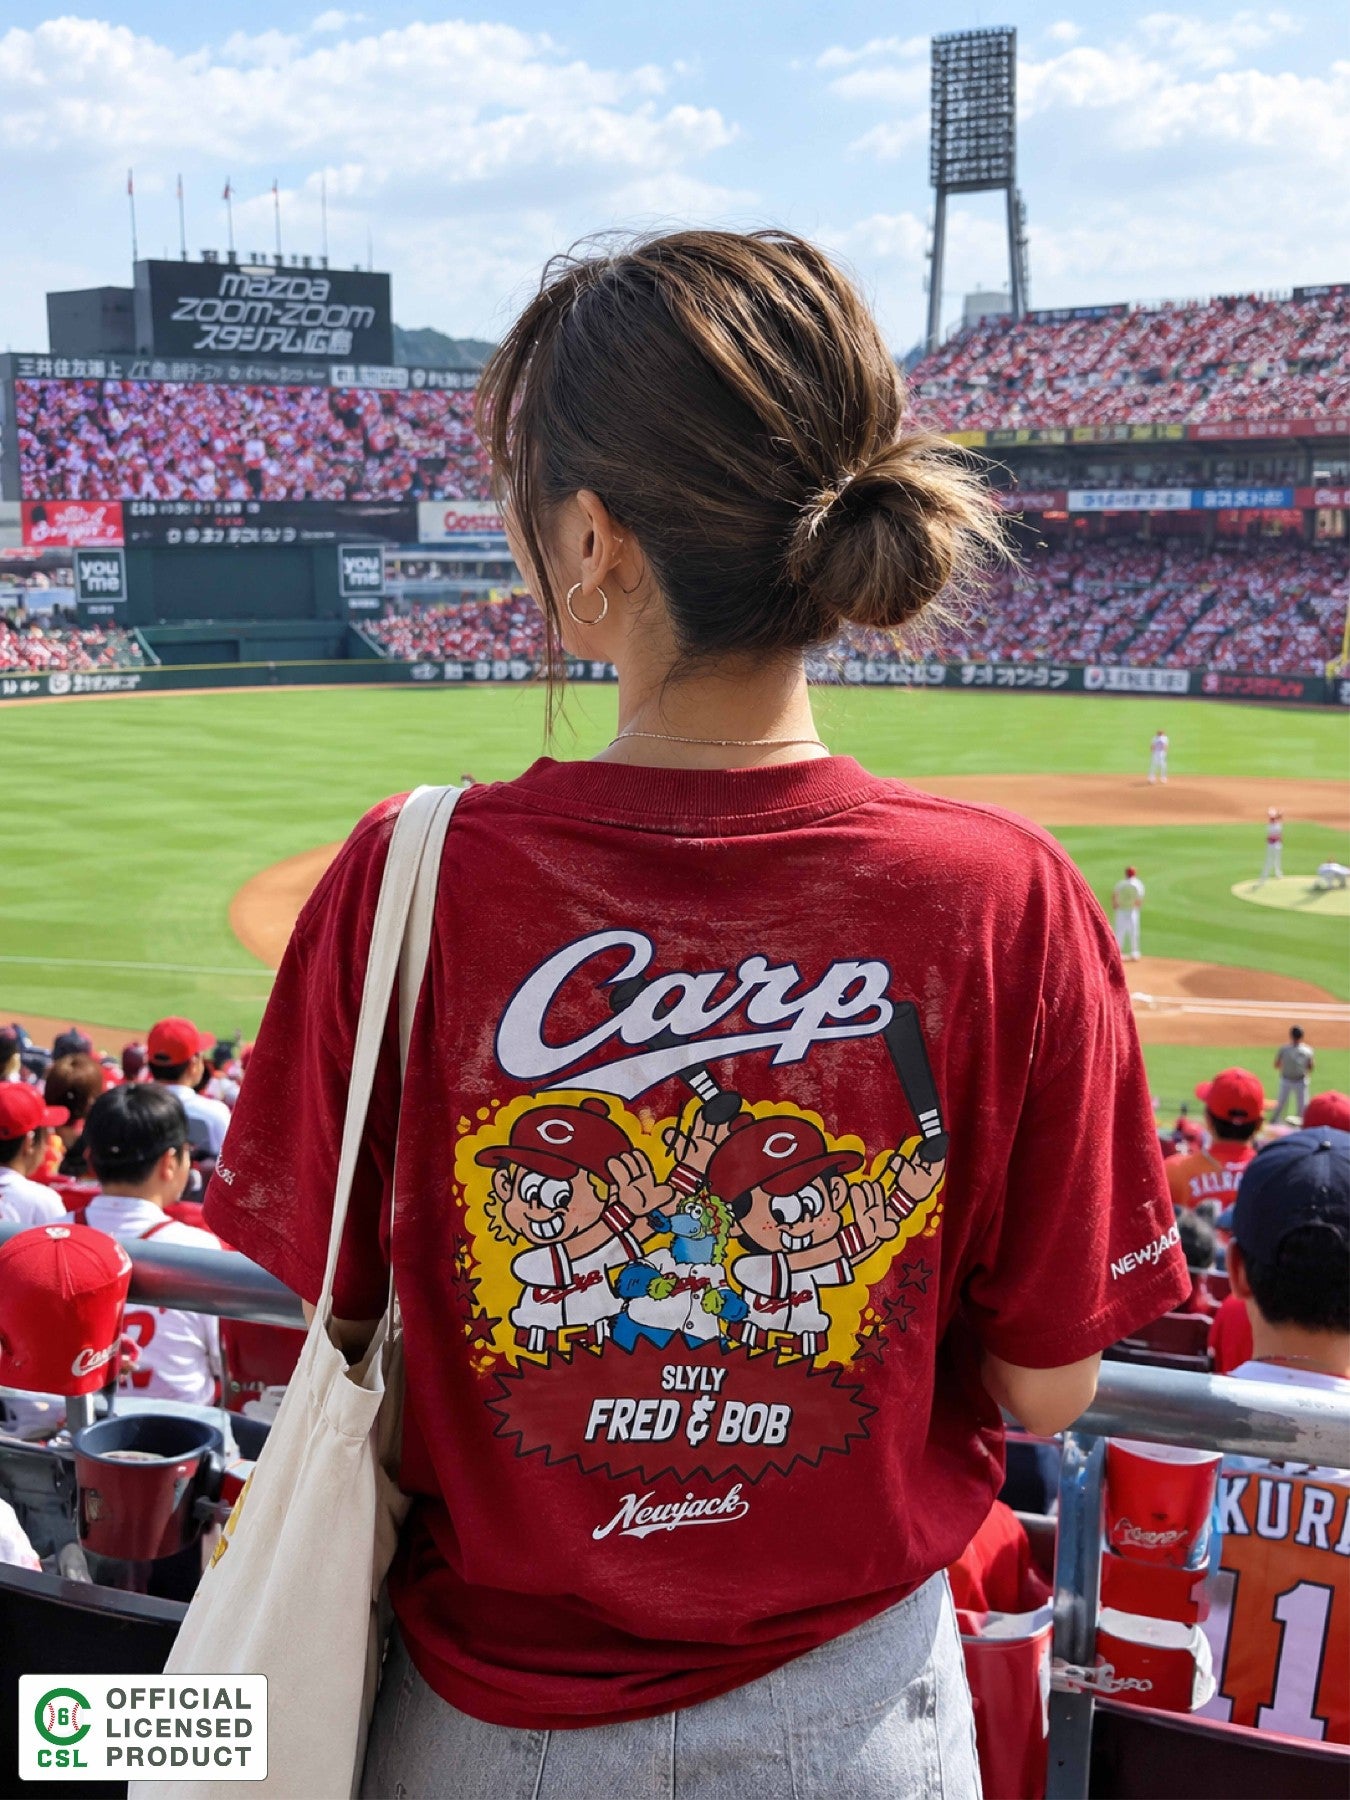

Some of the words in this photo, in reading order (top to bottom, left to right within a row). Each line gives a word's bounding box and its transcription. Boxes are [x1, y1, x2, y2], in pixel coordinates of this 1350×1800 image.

[80, 561, 119, 580] you
[344, 556, 379, 573] you
[87, 576, 120, 592] me
[350, 571, 380, 585] me
[494, 928, 895, 1100] Carp
[661, 1364, 727, 1393] SLYLY
[584, 1398, 682, 1443] FRED
[684, 1394, 715, 1446] &
[717, 1402, 792, 1446] BOB
[592, 1483, 750, 1540] Newjack
